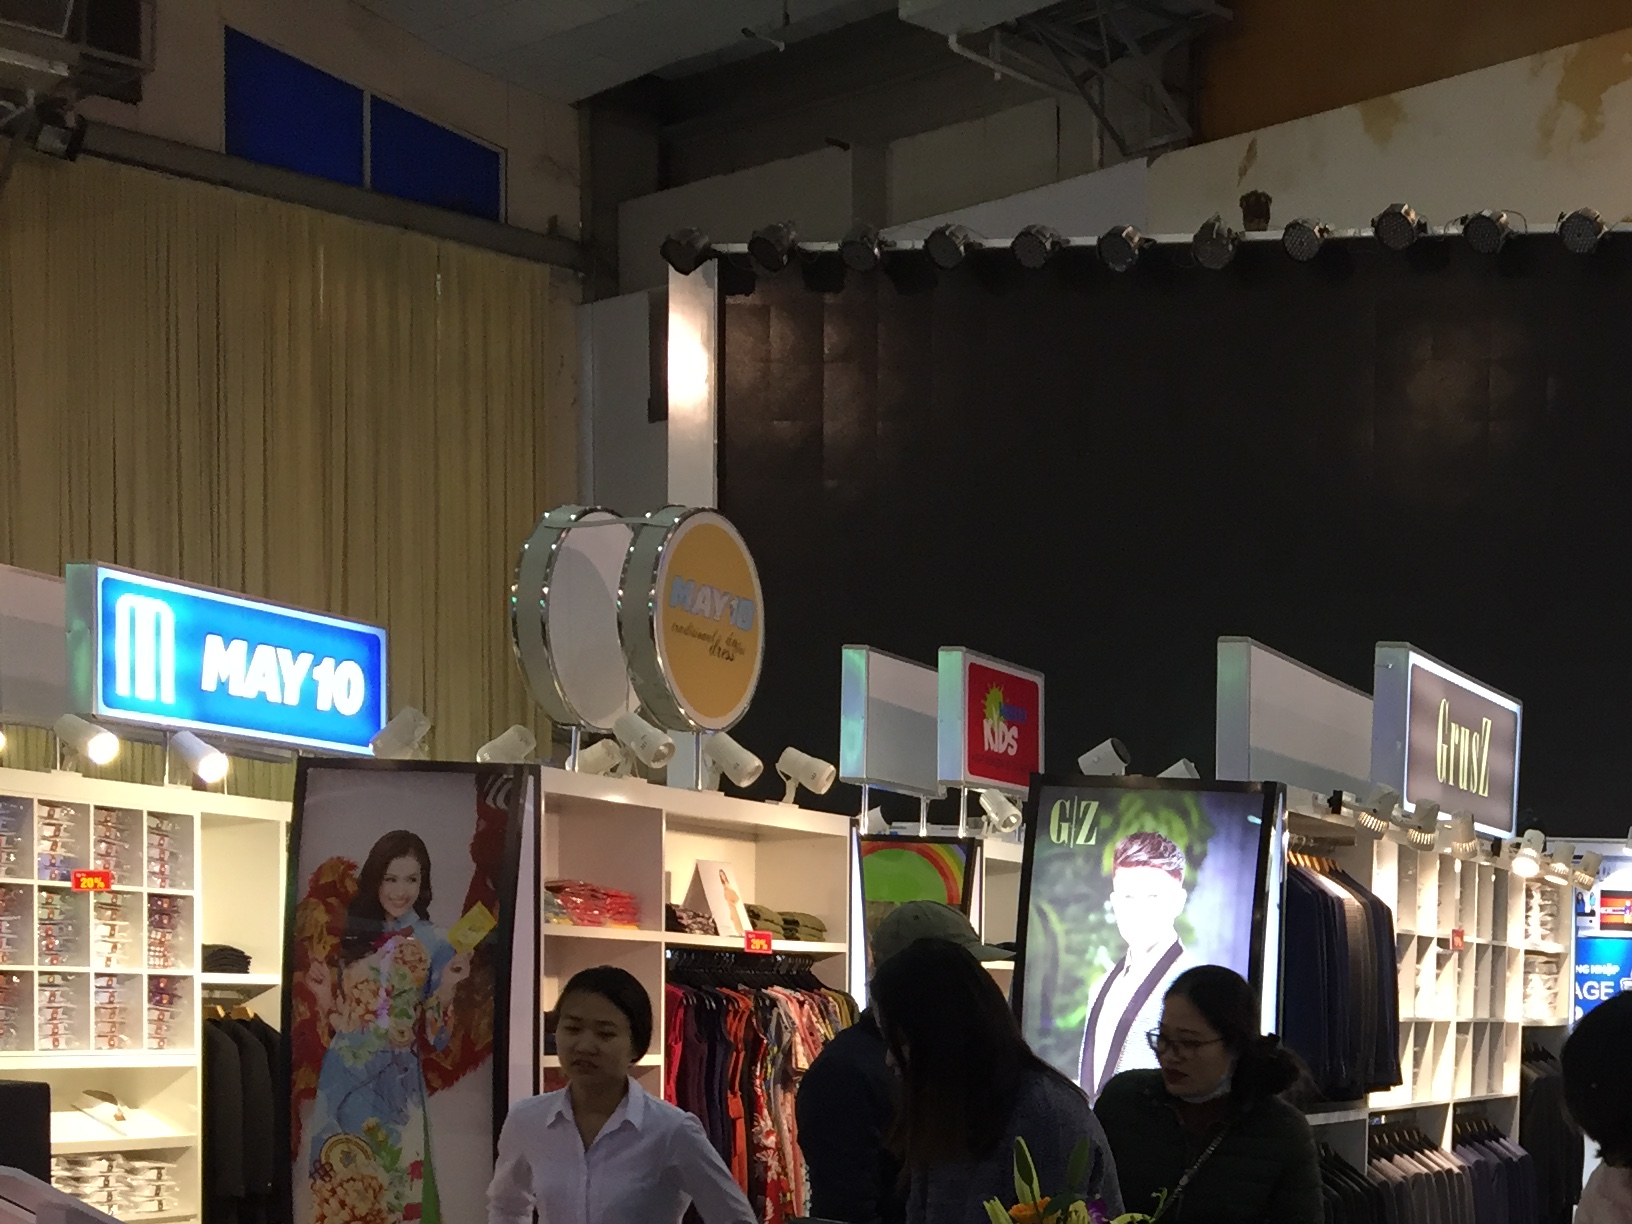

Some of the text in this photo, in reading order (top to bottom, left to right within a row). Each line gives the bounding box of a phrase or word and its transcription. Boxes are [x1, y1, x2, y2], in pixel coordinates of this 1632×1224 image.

[669, 575, 732, 623] MAY
[201, 632, 365, 716] MAY 10
[1436, 698, 1492, 798] GrusZ
[80, 877, 105, 889] 20%
